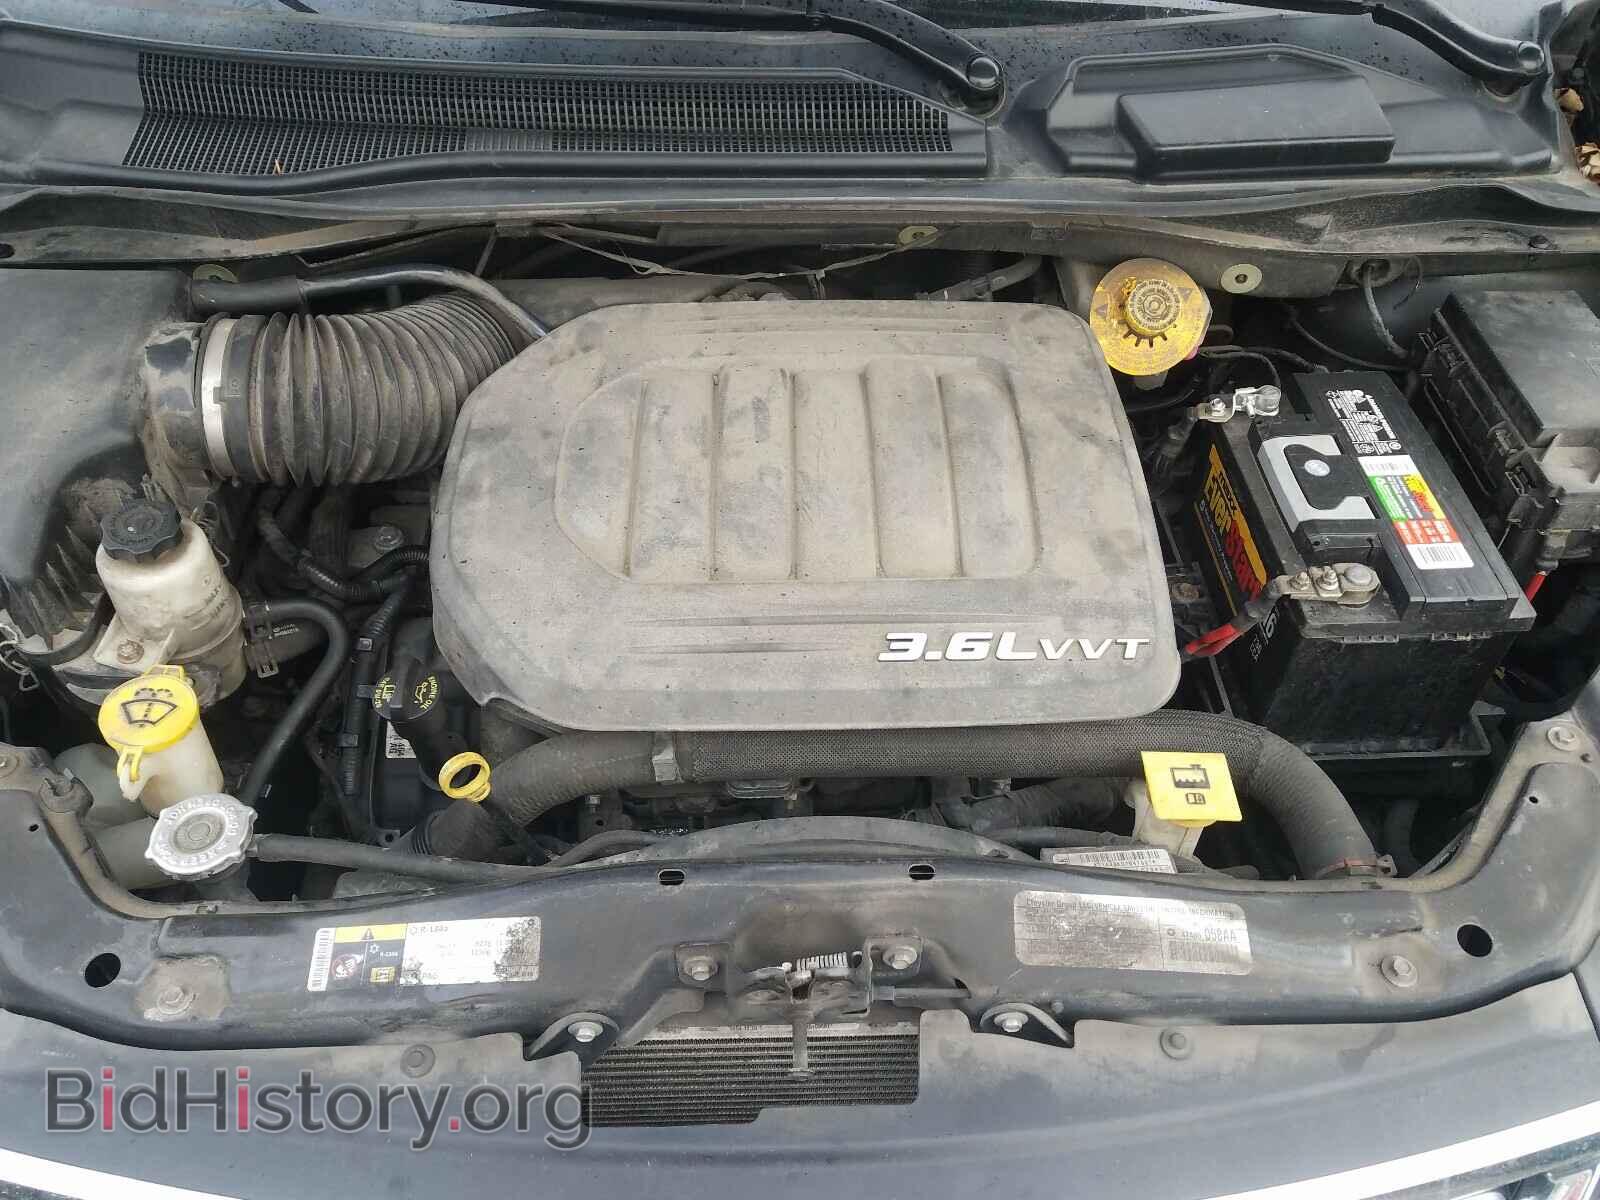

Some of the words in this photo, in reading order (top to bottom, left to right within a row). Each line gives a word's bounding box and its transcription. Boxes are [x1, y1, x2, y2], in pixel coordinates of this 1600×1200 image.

[878, 631, 1037, 661] 3.6L
[1039, 638, 1151, 660] VVT
[427, 676, 438, 699] ENGINE
[420, 699, 433, 710] OIL
